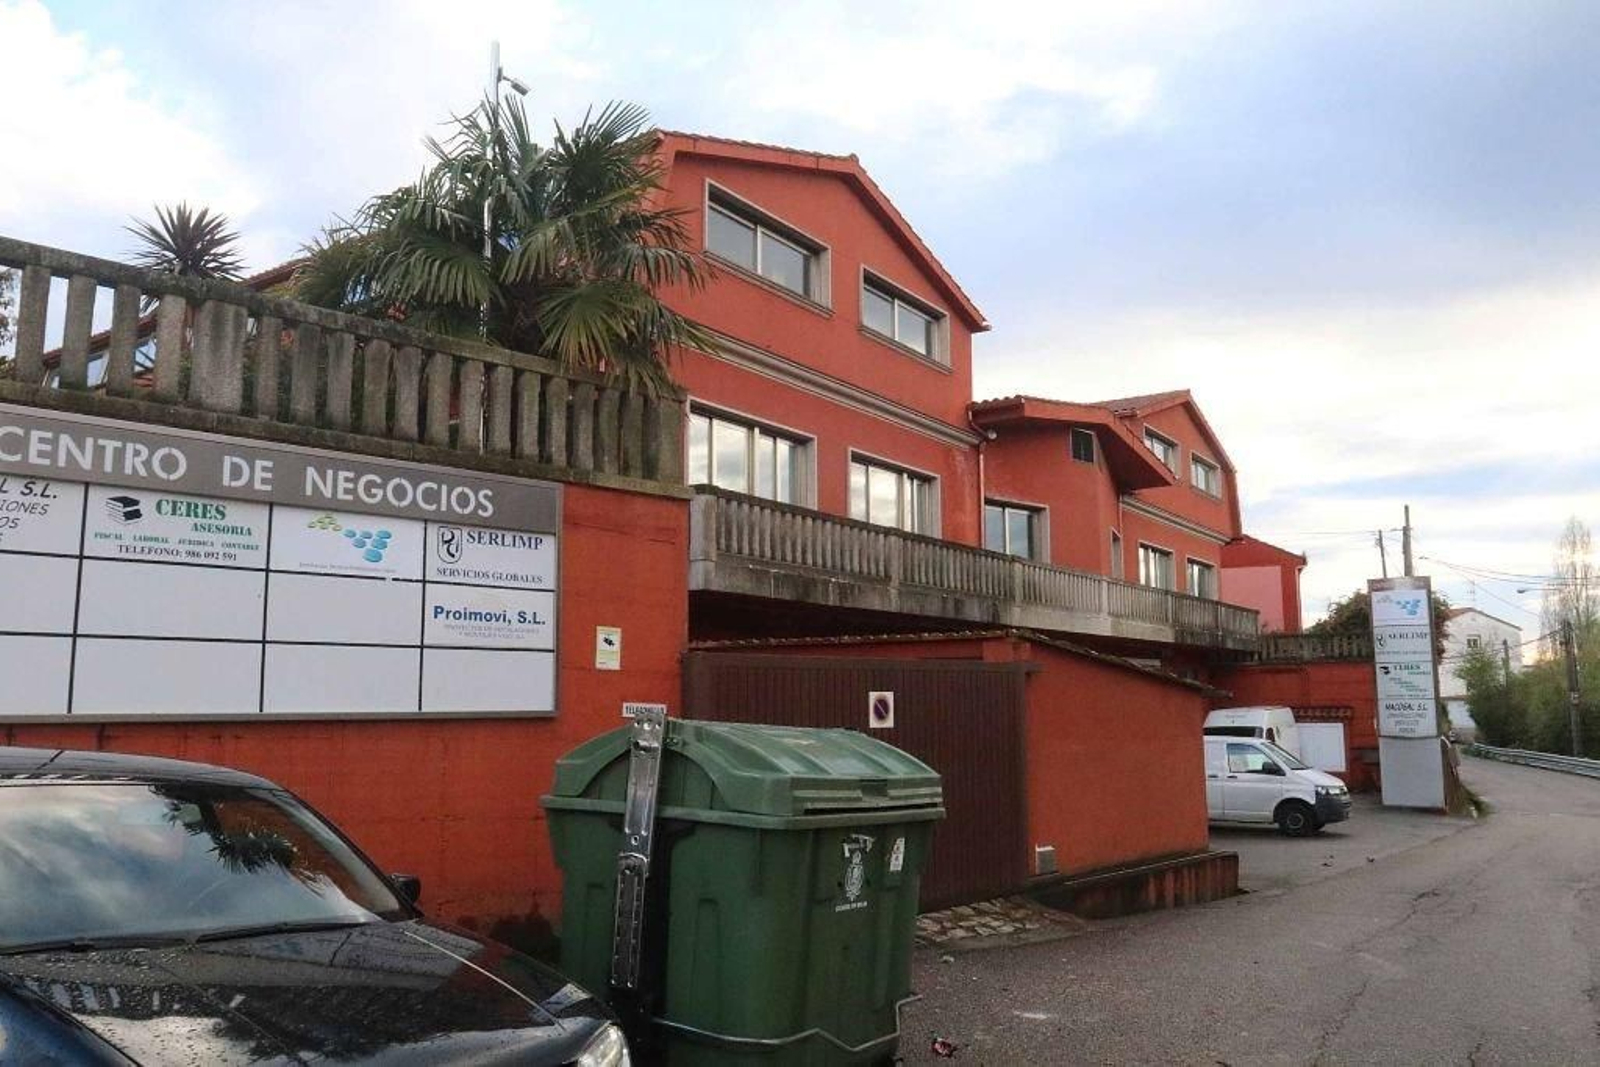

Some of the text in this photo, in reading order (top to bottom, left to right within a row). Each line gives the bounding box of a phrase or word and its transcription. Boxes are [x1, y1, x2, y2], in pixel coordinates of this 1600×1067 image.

[0, 426, 494, 518] CENTRO DE NEGOCIOS
[20, 481, 57, 499] S.L.
[155, 499, 227, 521] CERES
[191, 522, 253, 536] ASESORIA
[94, 532, 123, 541] FISCAL
[133, 535, 170, 544] LABORAL
[221, 542, 260, 551] CONTABLE
[466, 530, 543, 550] SERLIMP
[117, 544, 237, 561] TELEFONO: 986 092 591
[437, 567, 543, 584] SERVICIOS GLOBALES
[433, 605, 546, 626] Proimovi, S.L.
